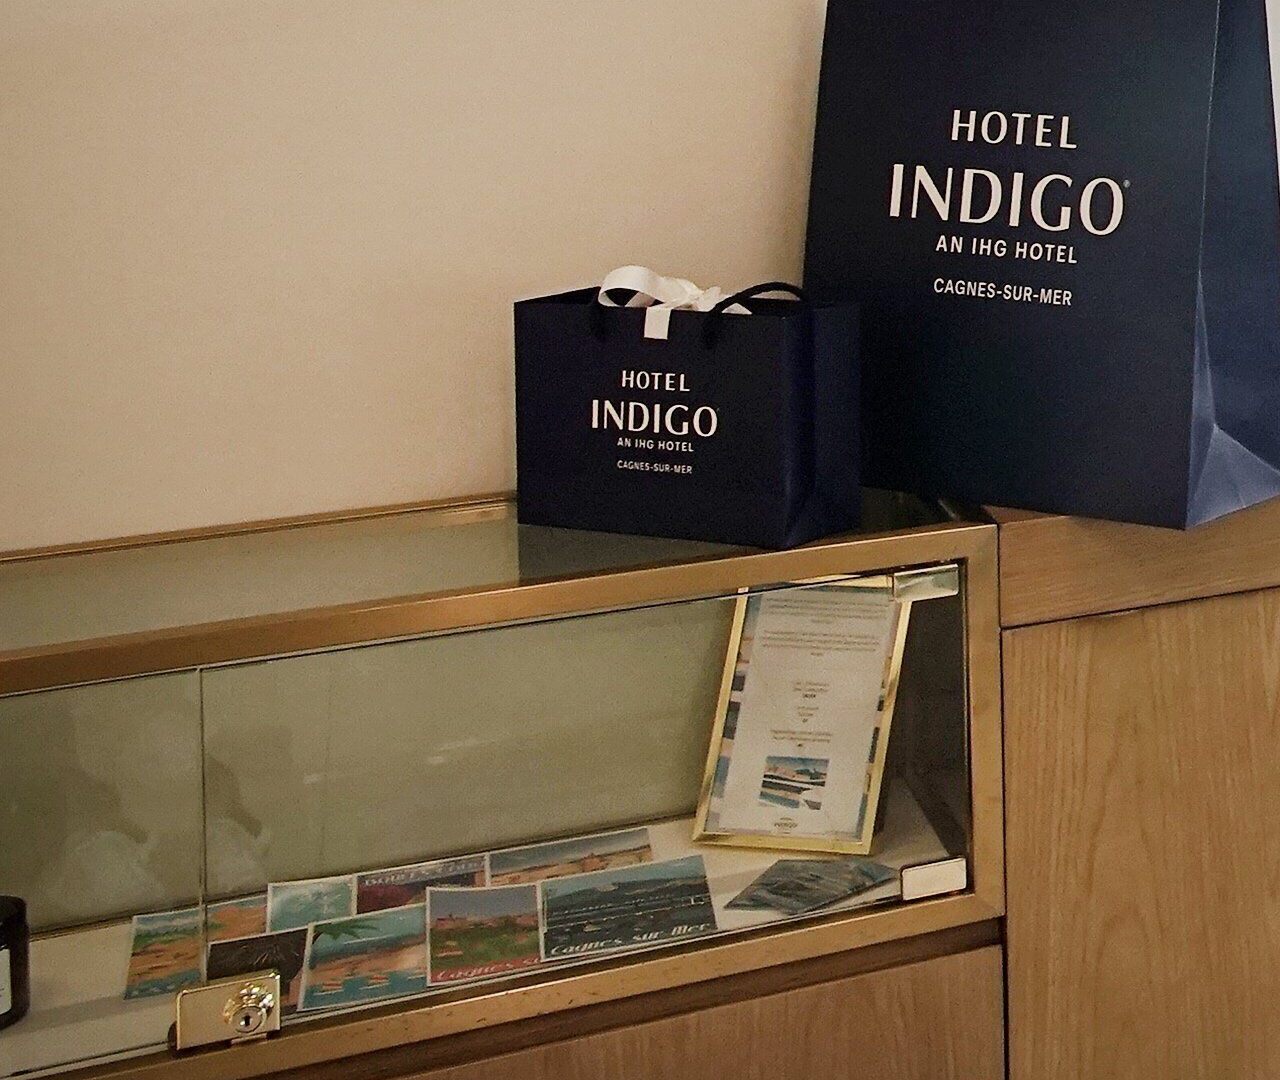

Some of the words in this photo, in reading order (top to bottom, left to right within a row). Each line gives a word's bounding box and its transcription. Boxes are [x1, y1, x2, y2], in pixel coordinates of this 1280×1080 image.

[951, 109, 1078, 149] HOTEL
[889, 163, 1125, 236] INDIGO
[935, 235, 963, 254] AN
[971, 237, 1007, 257] IHG
[1015, 241, 1077, 264] HOTEL
[933, 277, 1073, 306] CAGNES-SUR-MER
[621, 370, 691, 392] HOTEL
[591, 399, 718, 437] INDIGO
[616, 437, 632, 448] AN
[634, 439, 655, 450] IHG
[657, 440, 694, 452] HOTEL
[616, 459, 693, 475] CAGNES-SUR-MER
